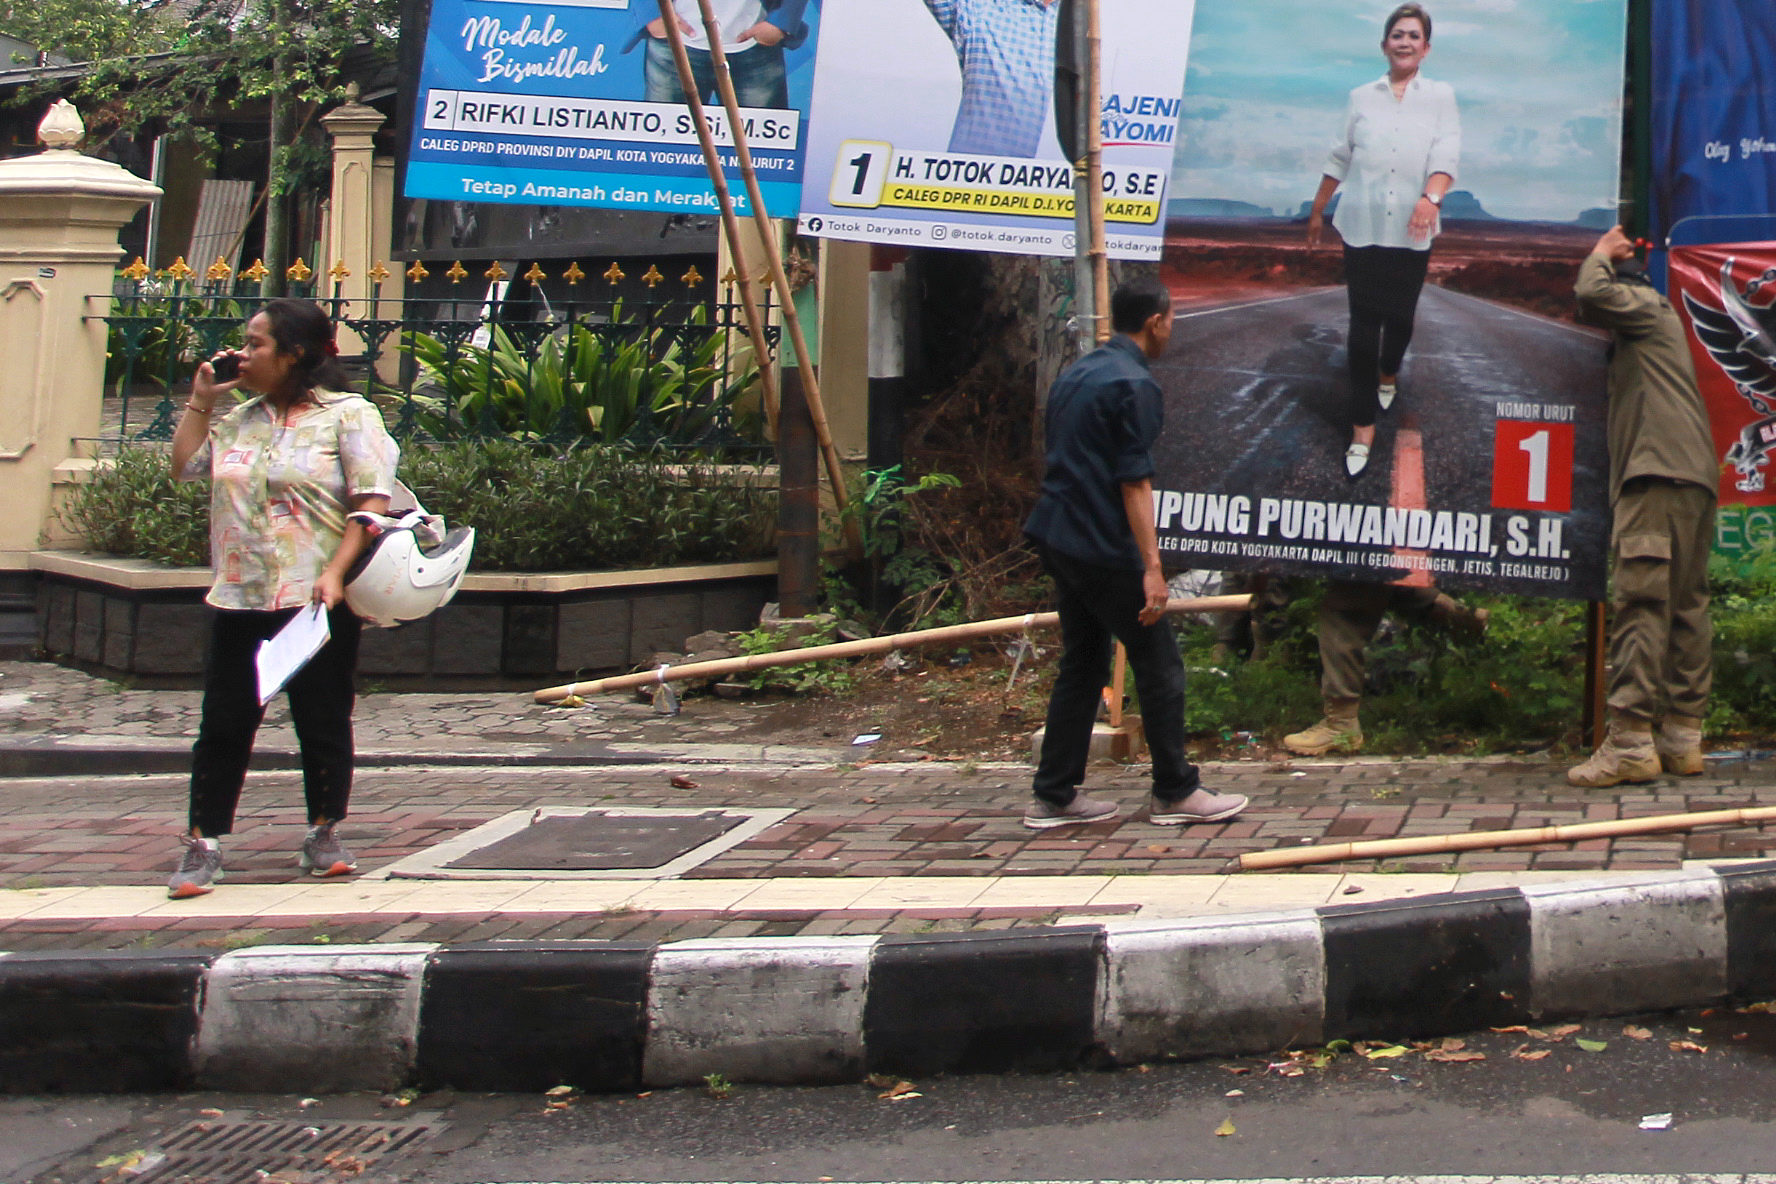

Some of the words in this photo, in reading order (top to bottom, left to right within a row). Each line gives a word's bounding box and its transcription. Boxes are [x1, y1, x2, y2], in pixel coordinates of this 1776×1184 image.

[461, 14, 568, 52] Modale
[477, 43, 609, 83] Bismillah
[433, 100, 448, 120] 2
[461, 102, 525, 125] RIFKI
[533, 106, 667, 137] LISTIANTO,
[1100, 94, 1182, 117] AJENI
[1101, 119, 1175, 143] AYOMI
[421, 138, 460, 153] CALEG
[462, 140, 496, 155] DPRD
[498, 142, 554, 158] PROVINSI
[556, 145, 577, 159] DIY
[579, 147, 614, 162] DAPIL
[616, 149, 648, 163] KOTA
[649, 151, 726, 167] YOGYAKAA
[786, 159, 795, 171] 2
[461, 177, 518, 199] Tetap
[522, 181, 606, 201] Amanah
[609, 185, 649, 204] dan
[850, 153, 871, 195] 1
[895, 156, 915, 179] H.
[924, 157, 993, 185] TOTOK
[999, 163, 1117, 197] DARYAO,
[1125, 173, 1158, 195] S.E
[894, 188, 940, 203] CALEG
[943, 191, 971, 206] DPR
[973, 193, 987, 206] RI
[990, 194, 1030, 210] DAPIL
[1033, 197, 1153, 218] D.I.YOKARTA
[828, 221, 860, 233] Totok
[867, 223, 922, 238] Daryanto
[951, 227, 1053, 246] @totok.daryanto
[1105, 240, 1162, 253] tokdarya
[1496, 401, 1540, 421] NOMOR
[1543, 404, 1576, 422] URUT
[1519, 430, 1550, 503] 1
[1258, 497, 1498, 558] PURWANDARI,
[1506, 515, 1571, 559] S.H.
[1157, 536, 1178, 550] LEG
[1180, 537, 1209, 553] DPRD
[1211, 539, 1239, 555] KOTA
[1241, 542, 1309, 561] YOGYAKARTA
[1311, 547, 1343, 565] DAPIL
[1346, 548, 1359, 565] III
[1500, 563, 1561, 581] TEGALREJO
